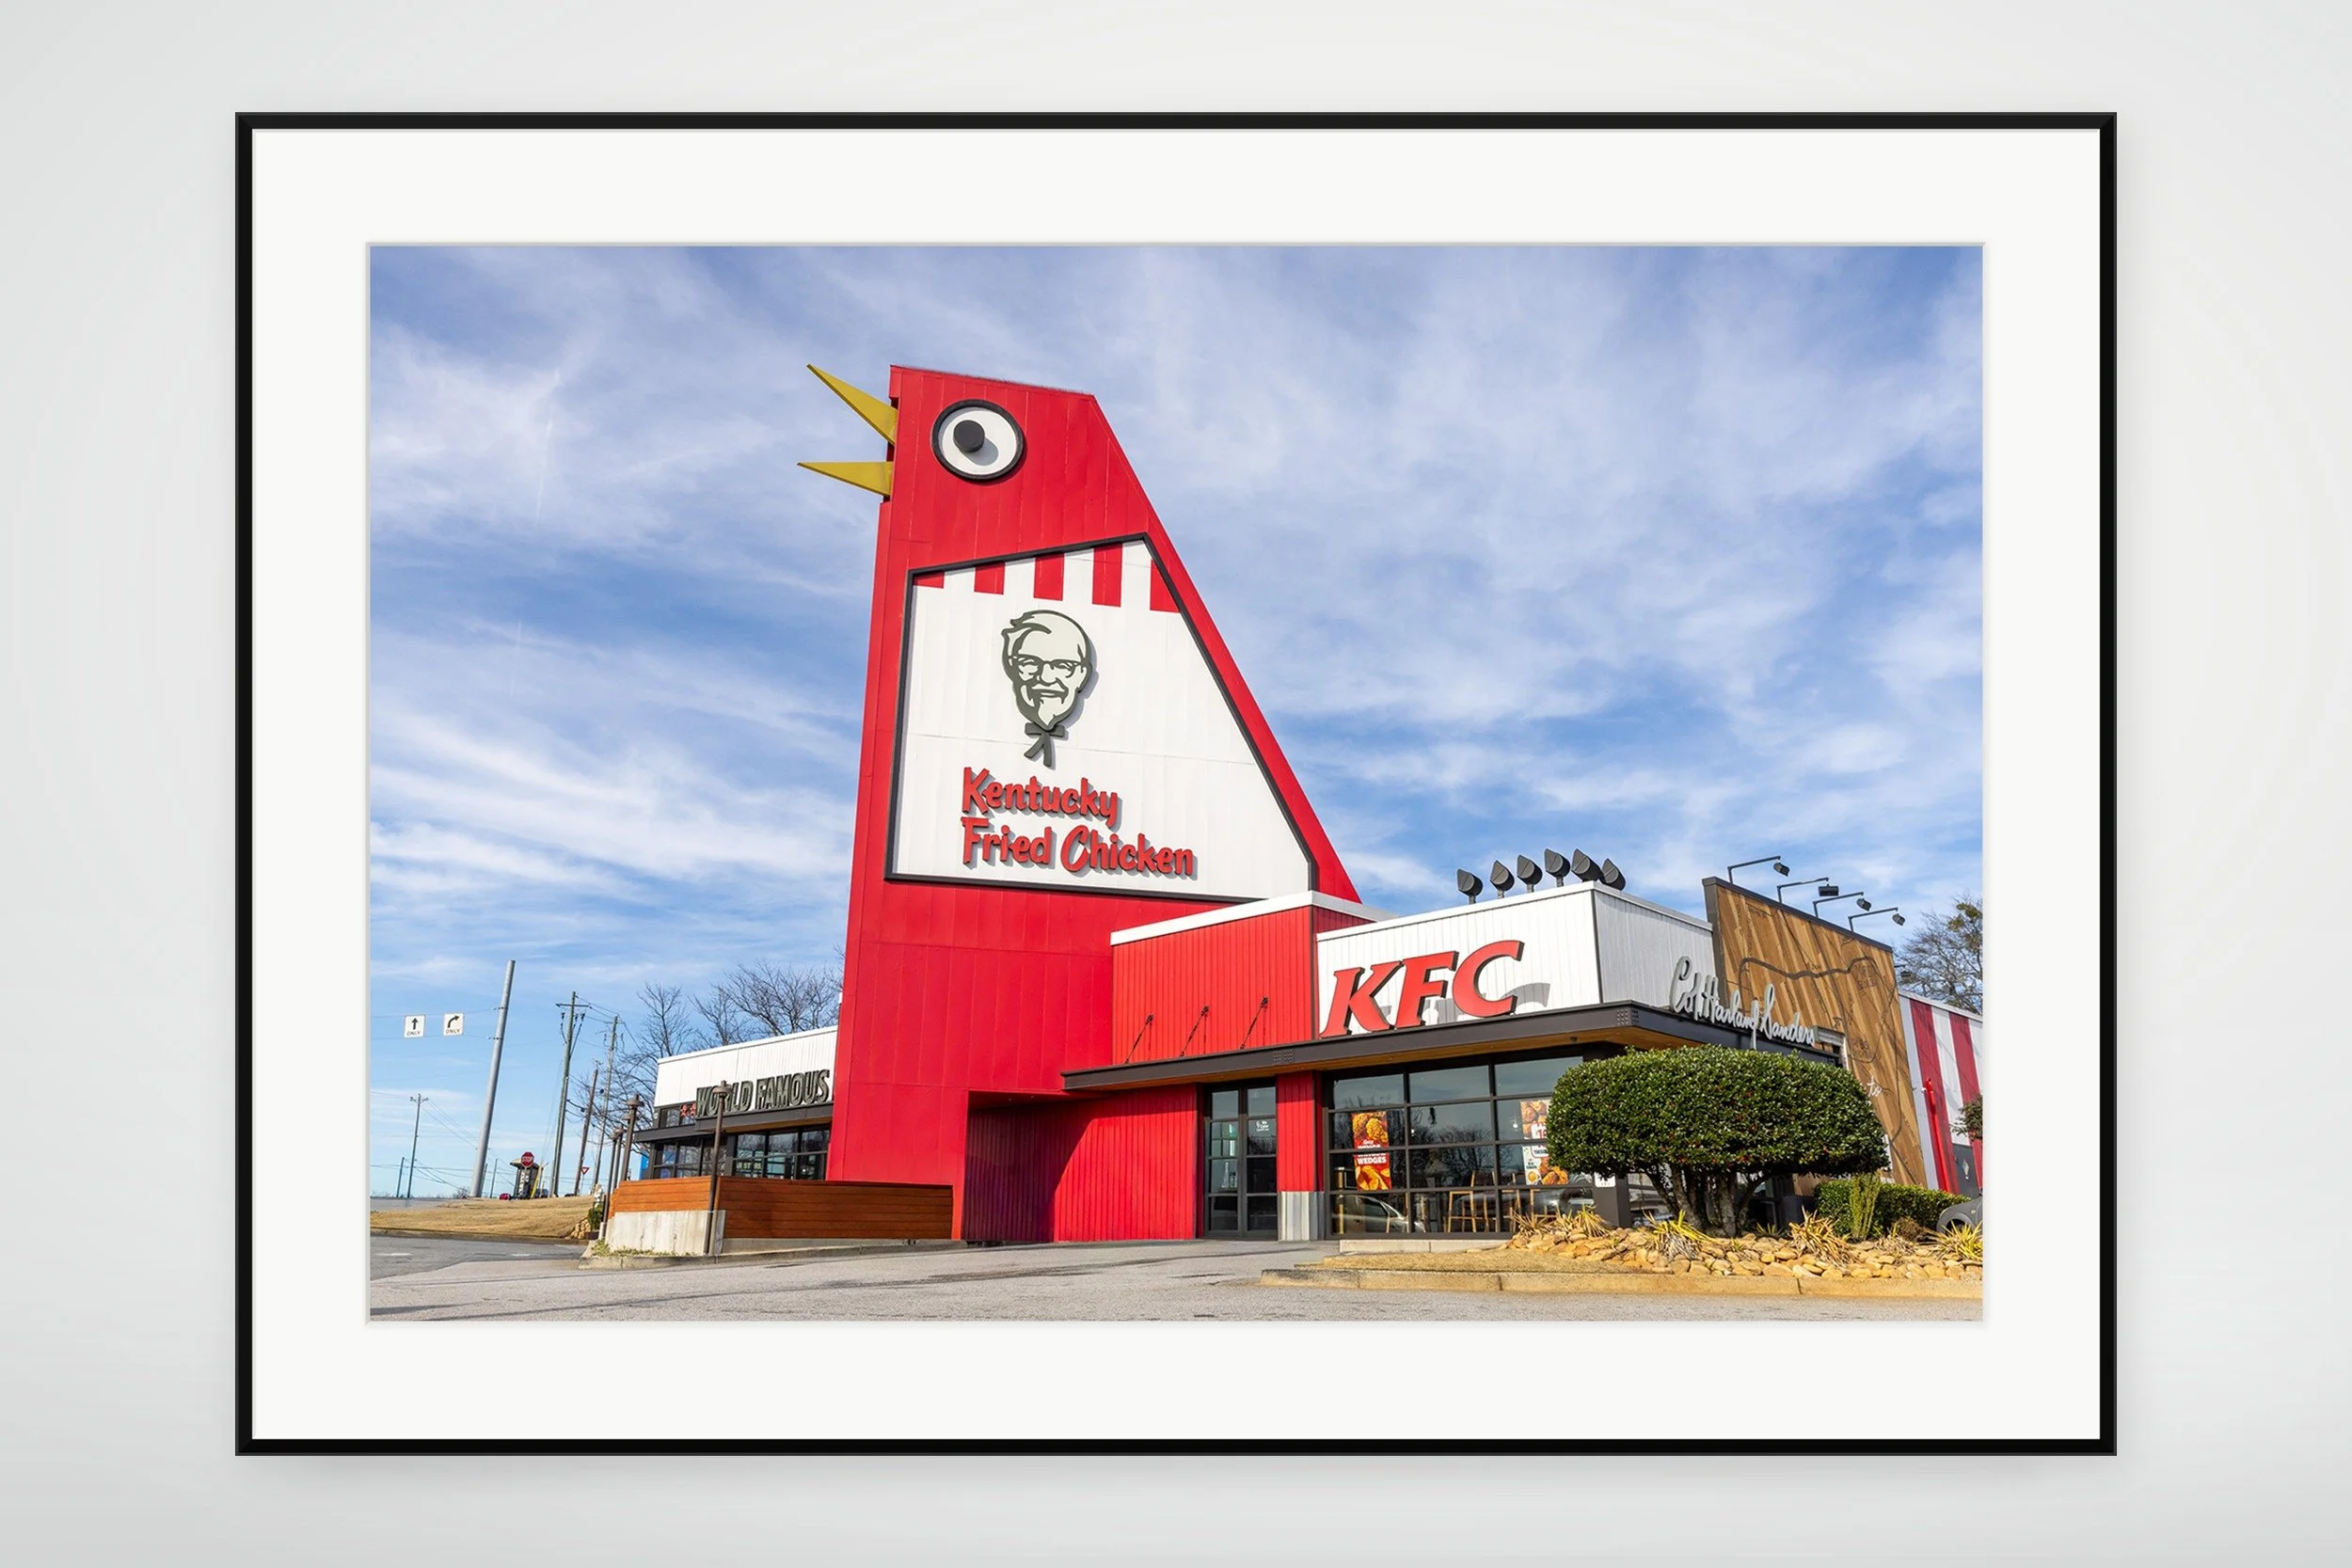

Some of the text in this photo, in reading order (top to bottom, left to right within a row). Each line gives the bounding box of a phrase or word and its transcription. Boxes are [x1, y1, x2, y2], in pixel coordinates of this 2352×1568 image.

[961, 767, 1119, 829] Kentucky
[961, 816, 1194, 877] Fried Chicken
[1319, 940, 1525, 1038] KFC
[1759, 983, 1816, 1049] Sanders
[755, 1069, 830, 1111] FAMOUS
[1358, 1156, 1388, 1165] WEDGES
